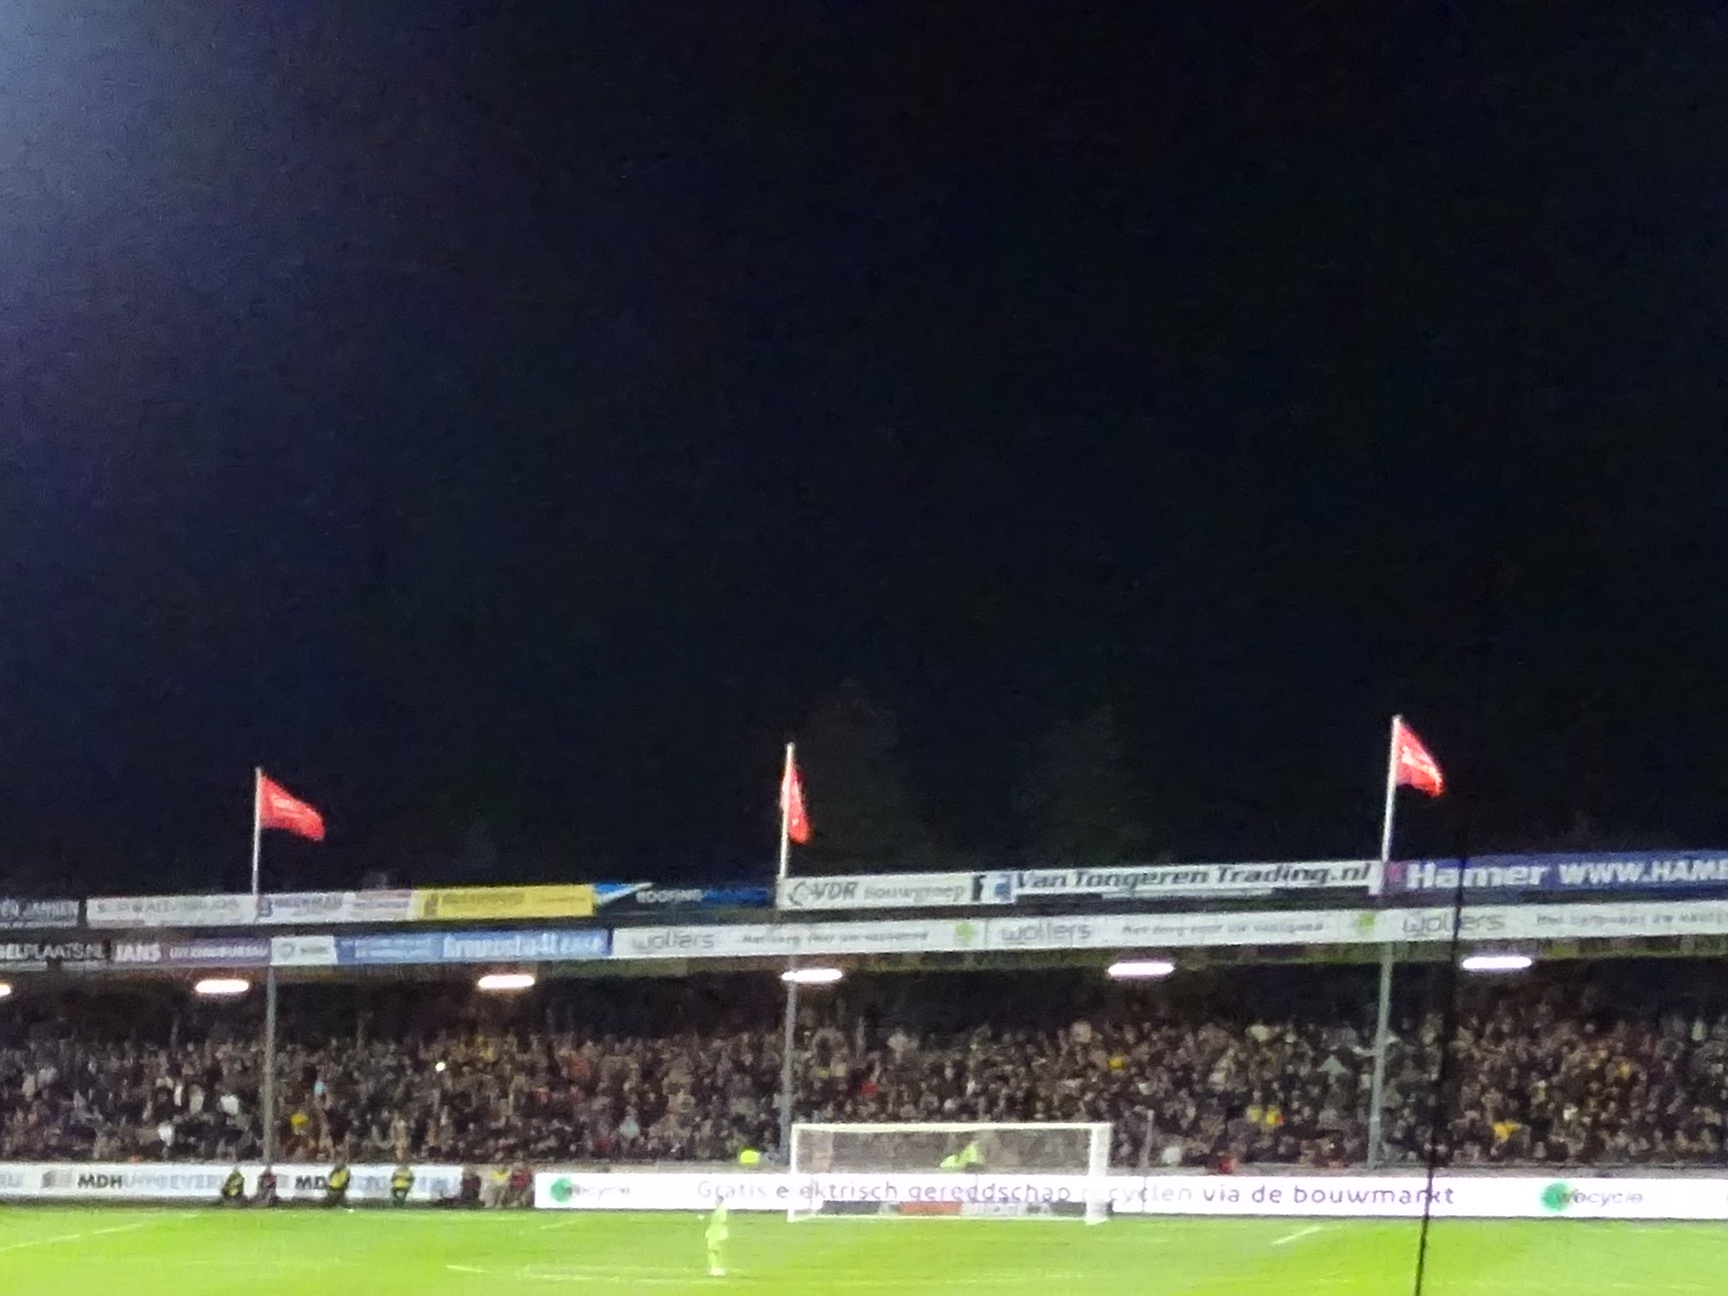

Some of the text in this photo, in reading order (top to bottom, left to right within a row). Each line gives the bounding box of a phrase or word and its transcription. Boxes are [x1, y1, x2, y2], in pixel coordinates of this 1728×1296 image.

[1016, 861, 1371, 895] Van Tongeren Trading.nl
[1406, 861, 1549, 889] Hamer
[810, 880, 859, 900] VDR
[77, 1172, 123, 1190] MDH
[295, 1175, 328, 1191] MD
[696, 1179, 767, 1200] Gratis
[775, 1178, 898, 1201] eektrisch
[1203, 1184, 1240, 1203] via
[1251, 1184, 1283, 1204] de
[1293, 1184, 1454, 1205] bouwmarkt
